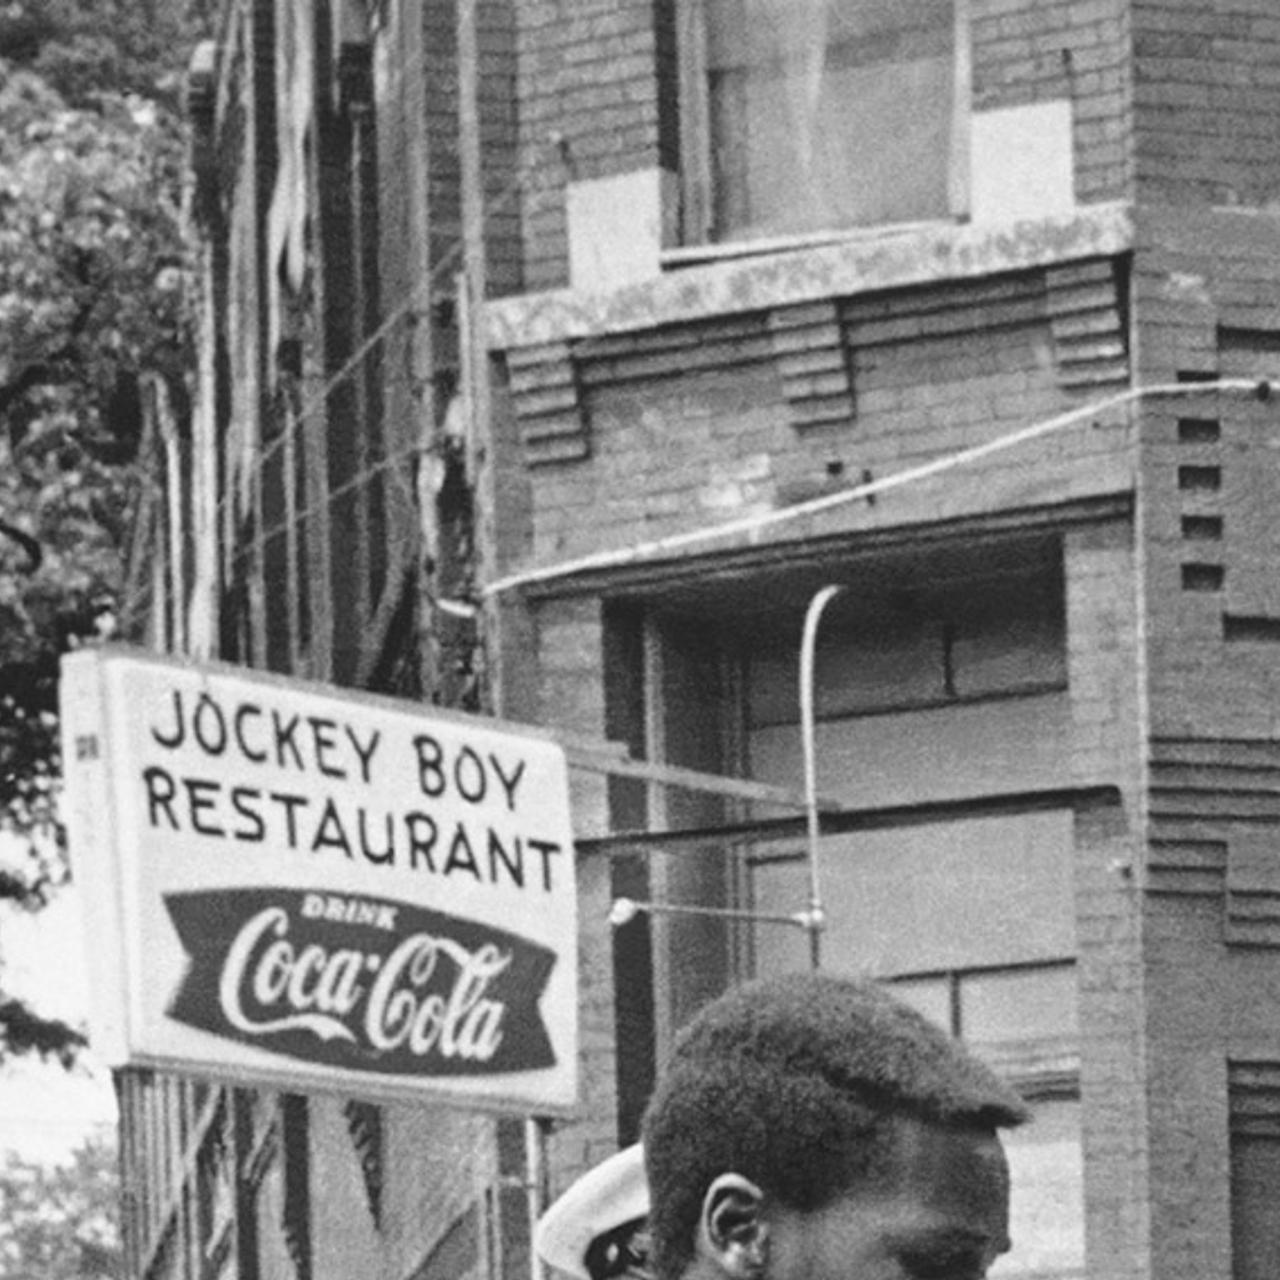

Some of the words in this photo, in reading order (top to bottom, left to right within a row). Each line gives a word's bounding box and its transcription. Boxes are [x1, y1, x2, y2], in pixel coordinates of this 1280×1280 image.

[151, 691, 380, 783] JOCKEY
[412, 735, 526, 811] BOY
[142, 766, 561, 892] RESTAURANT
[301, 894, 399, 931] DRINK
